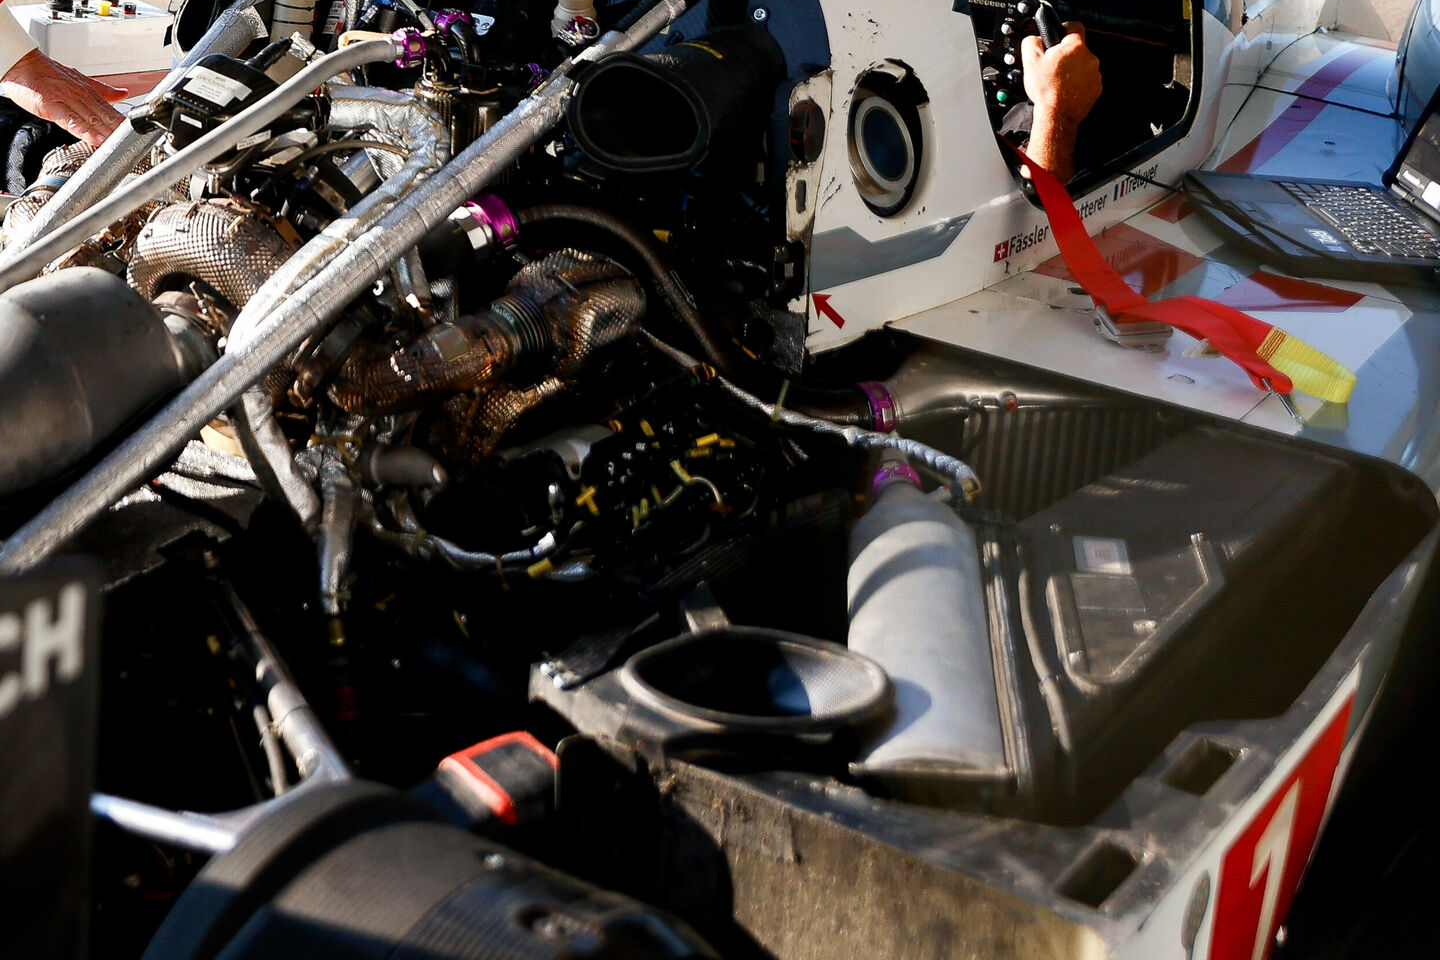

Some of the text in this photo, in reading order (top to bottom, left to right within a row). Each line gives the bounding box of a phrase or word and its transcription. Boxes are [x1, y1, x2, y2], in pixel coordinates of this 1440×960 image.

[1077, 194, 1108, 220] tterer
[1009, 224, 1049, 257] Fässler
[1248, 776, 1302, 960] 1
